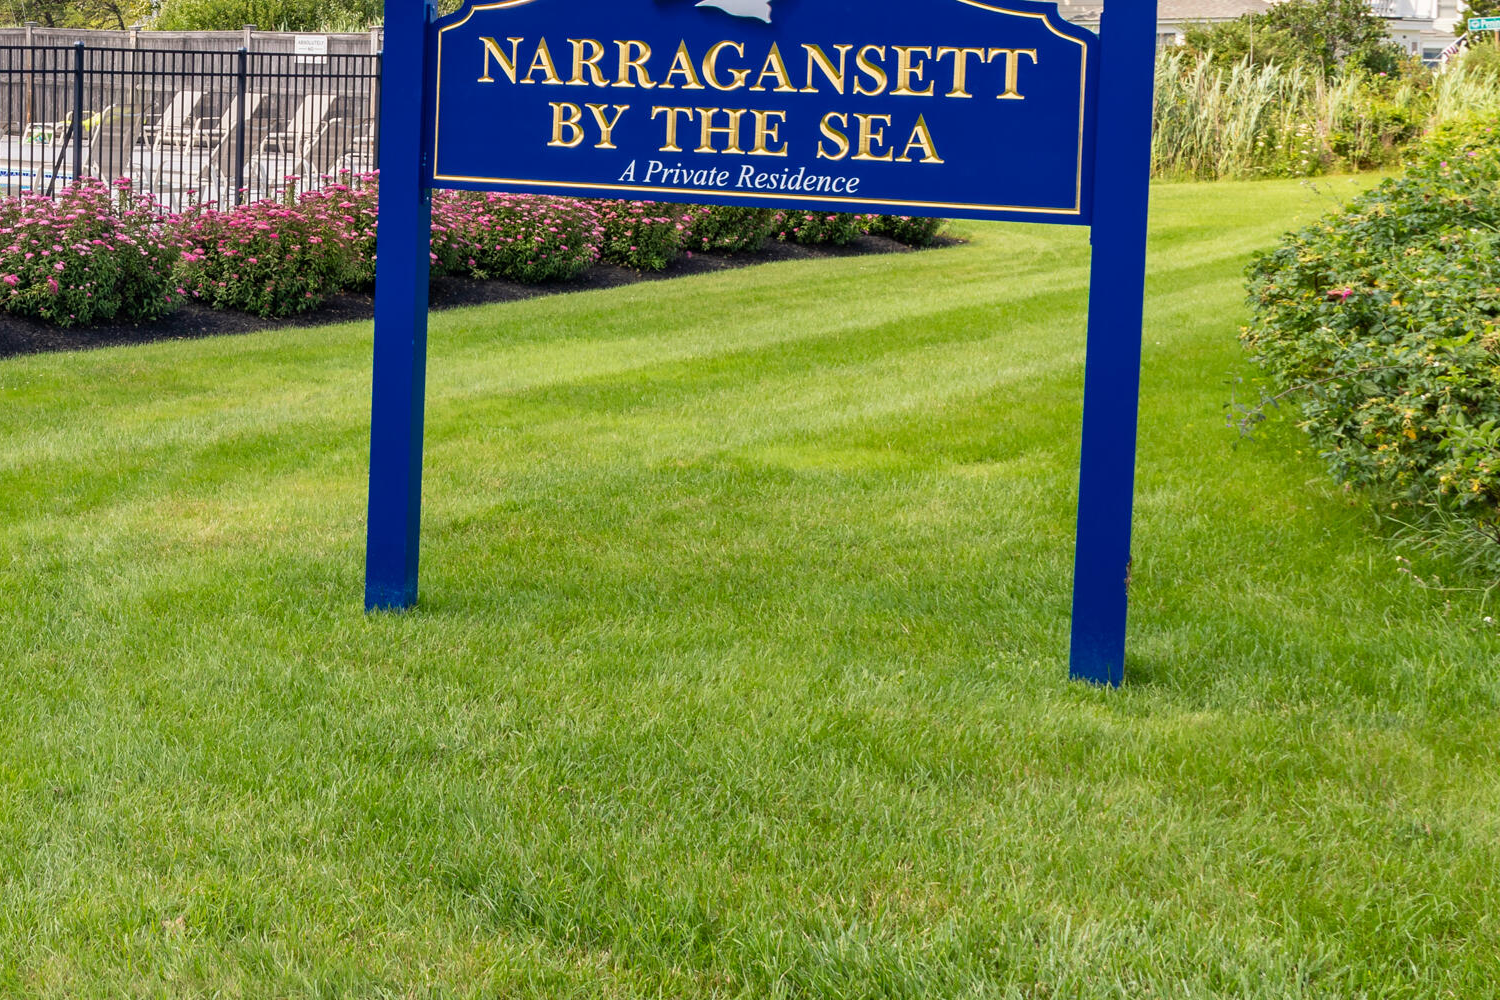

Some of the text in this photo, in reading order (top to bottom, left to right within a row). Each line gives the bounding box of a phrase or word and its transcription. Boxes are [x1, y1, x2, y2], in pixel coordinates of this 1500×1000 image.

[476, 36, 1039, 100] NARRAGANSETT
[546, 101, 945, 165] BY THE SEA
[617, 160, 861, 194] A Private Residence
